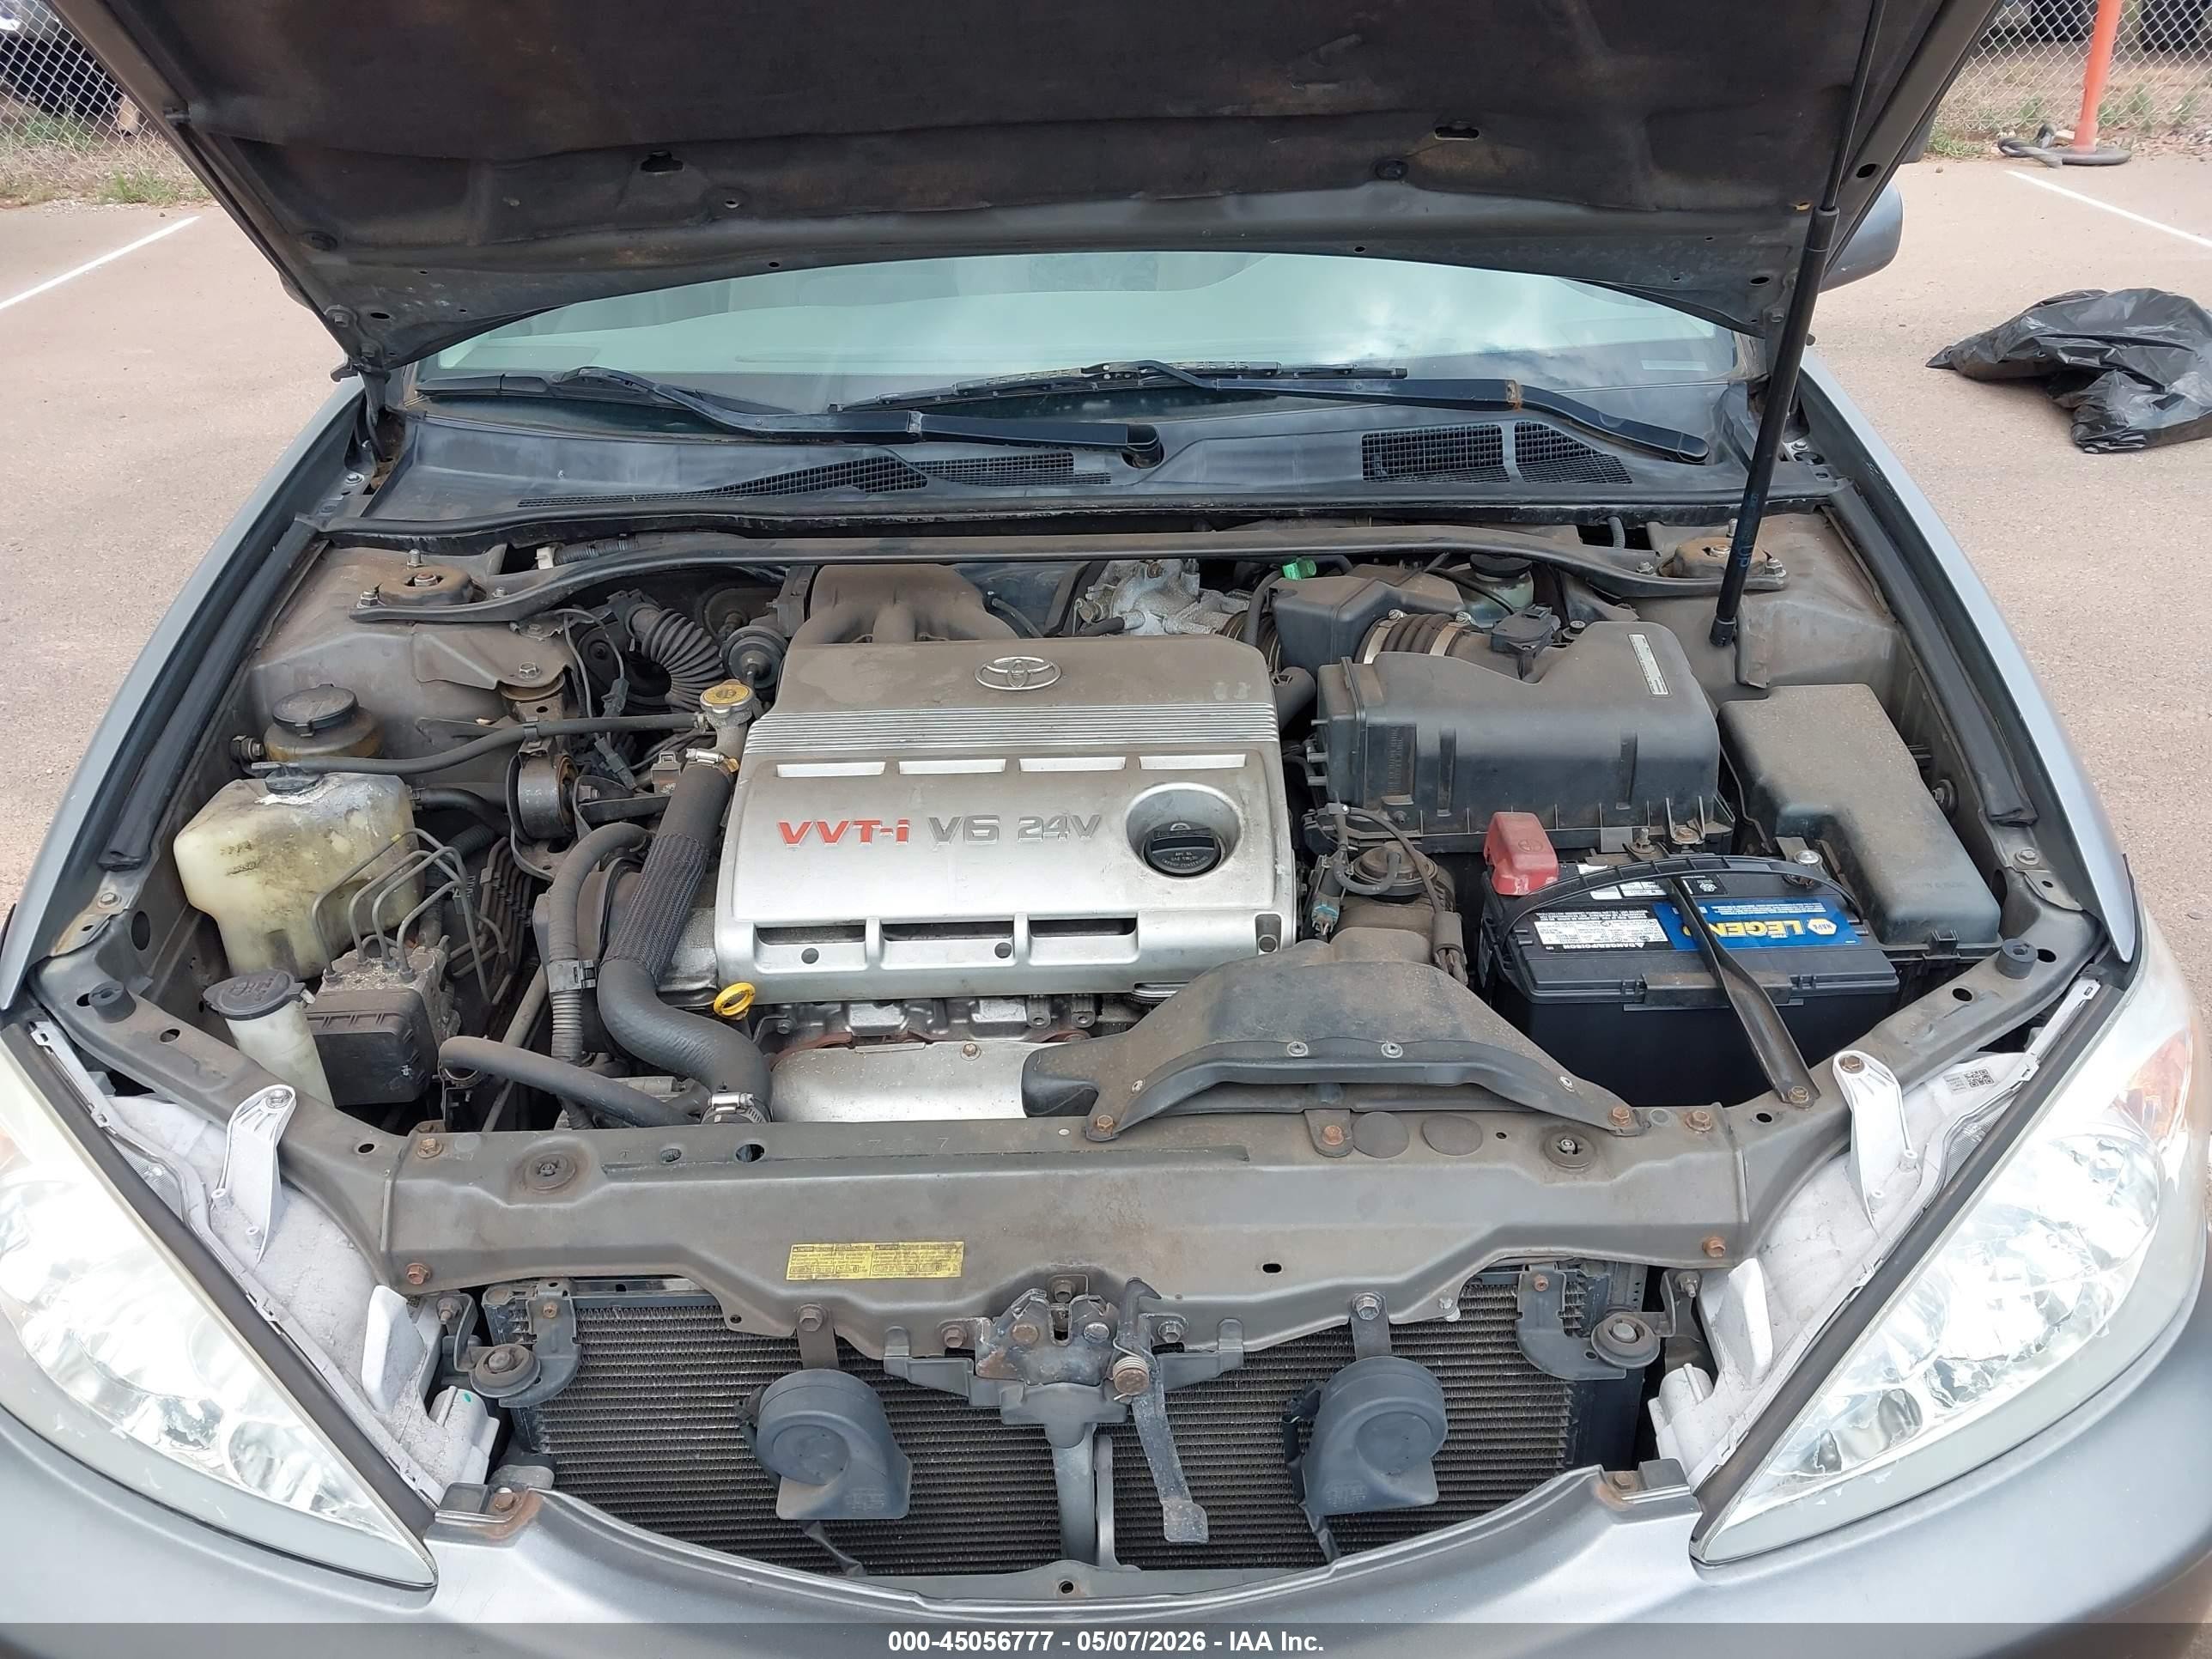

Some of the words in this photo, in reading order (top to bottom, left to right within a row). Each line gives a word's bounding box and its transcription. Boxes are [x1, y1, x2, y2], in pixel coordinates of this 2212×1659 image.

[777, 818, 910, 846] VVT-i
[927, 815, 1000, 846] V6
[1017, 813, 1102, 843] 24V
[1683, 920, 1805, 938] LEGEN
